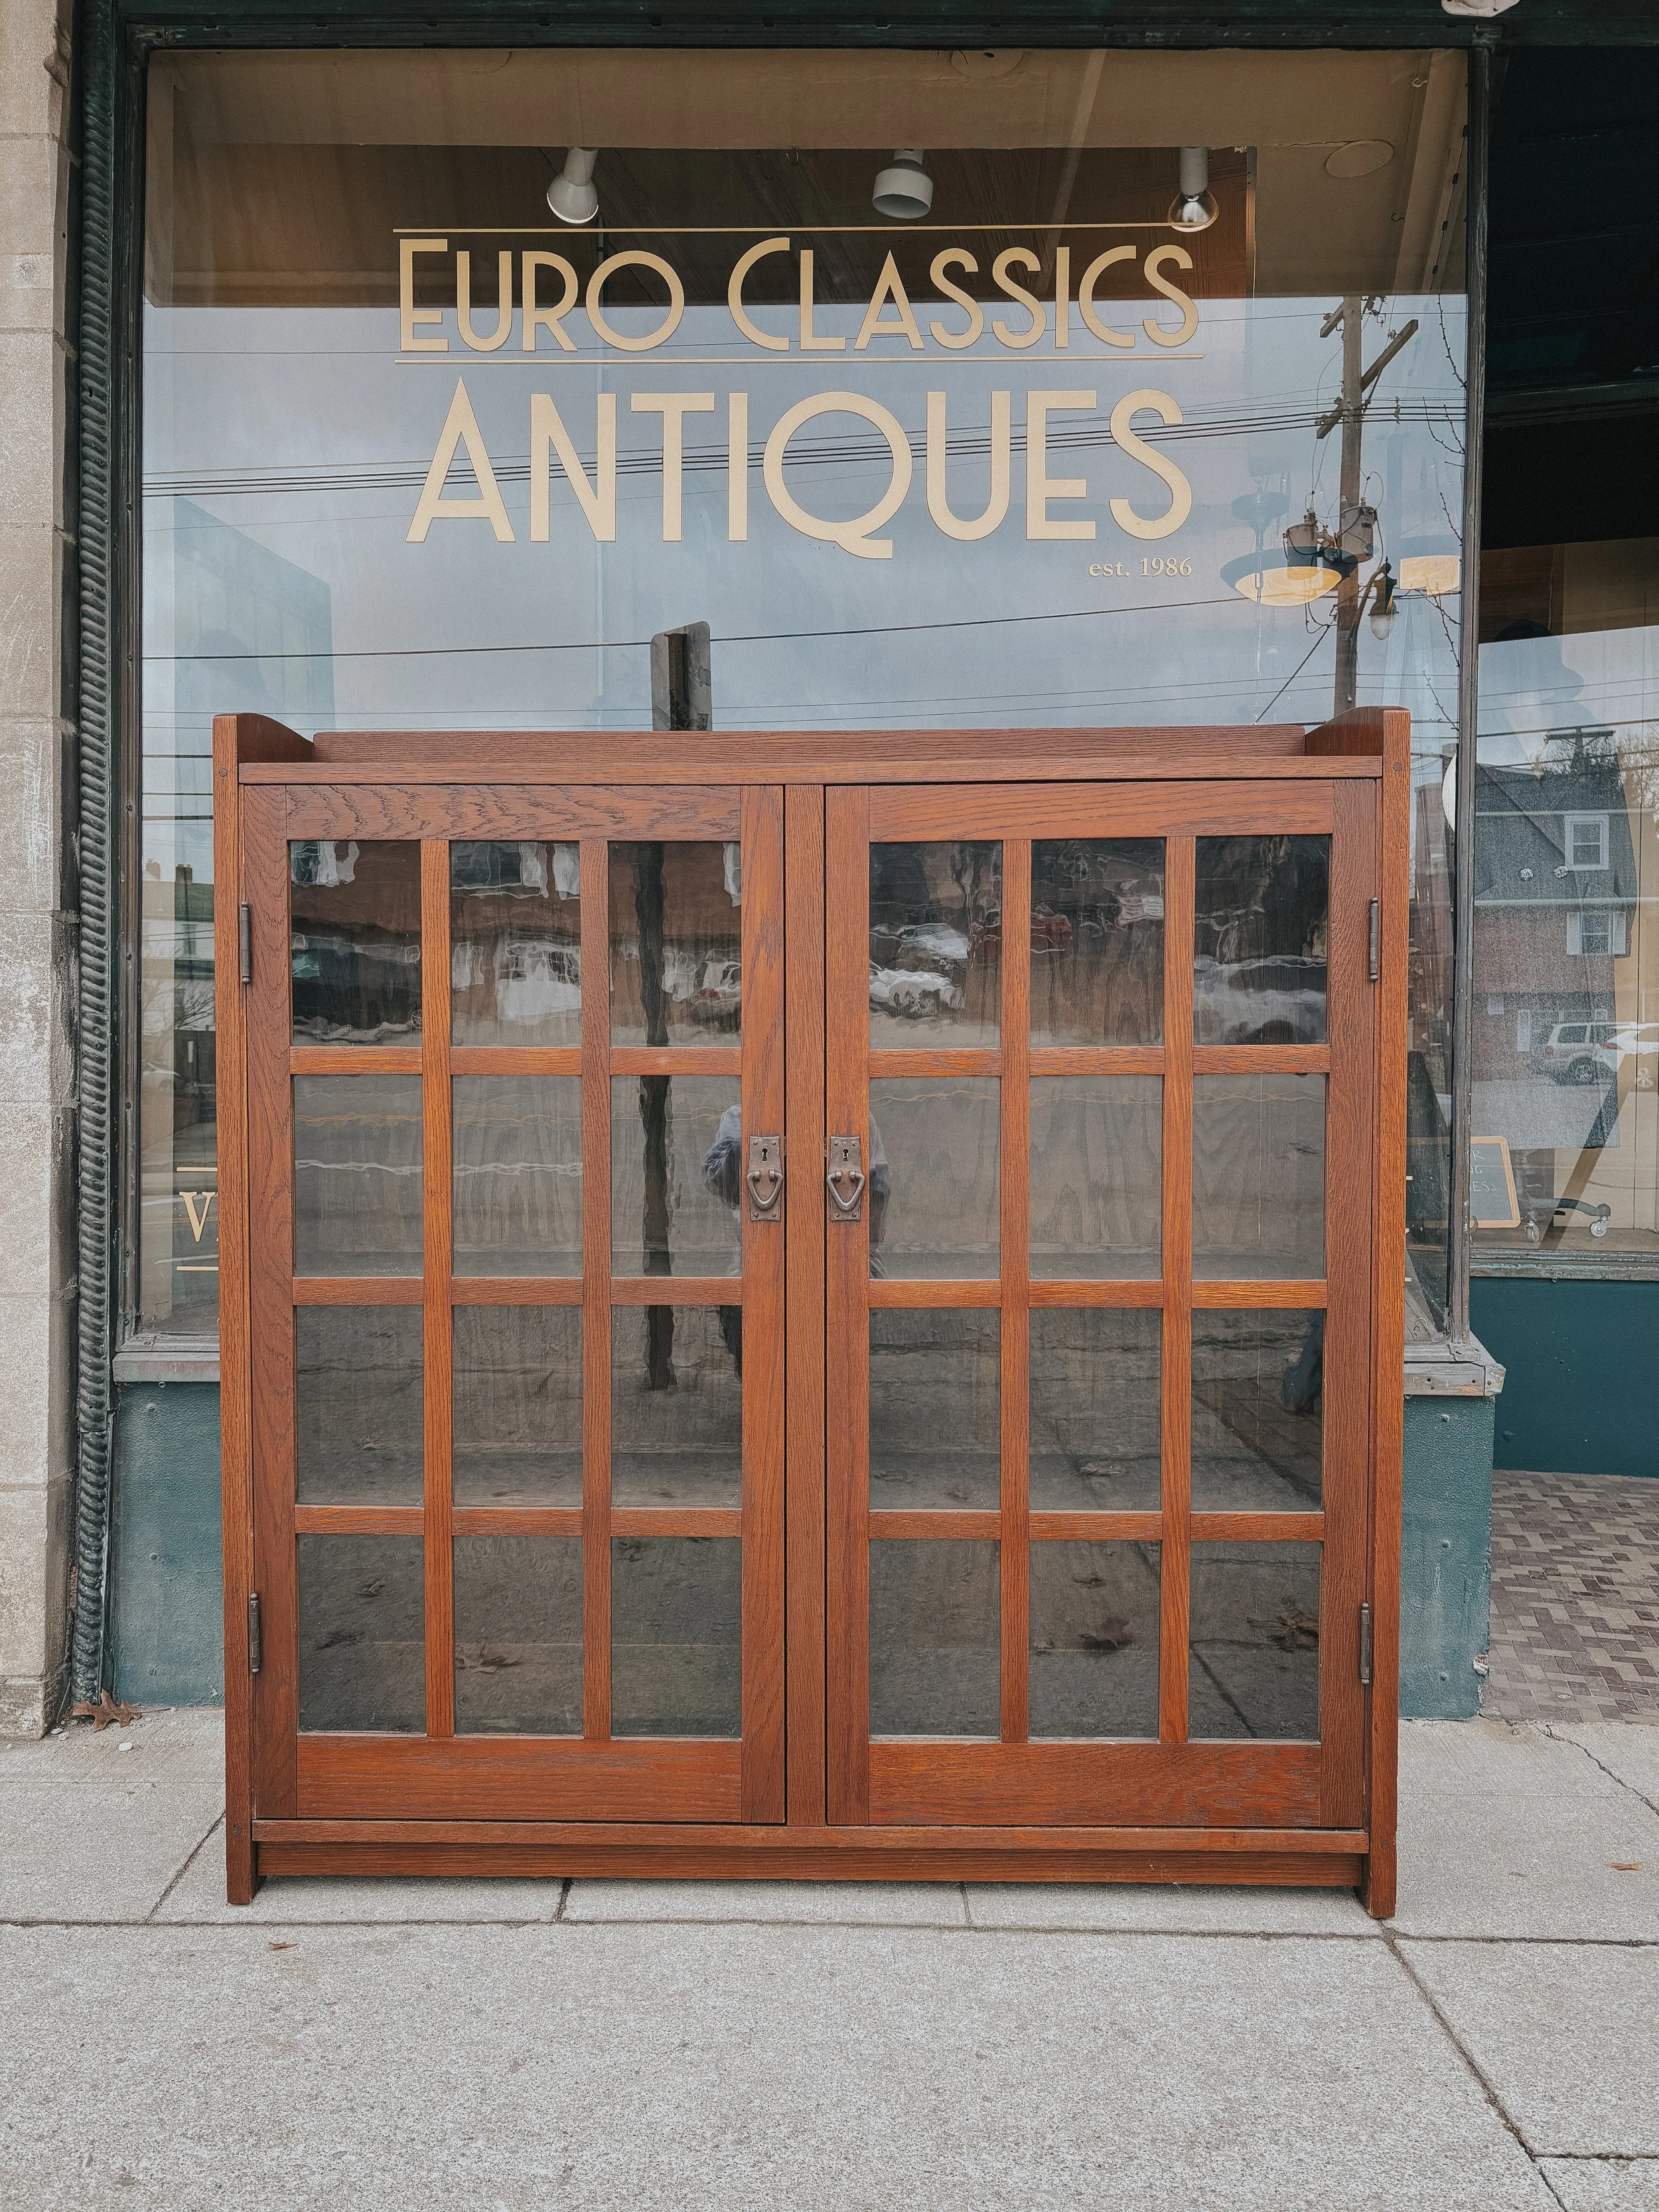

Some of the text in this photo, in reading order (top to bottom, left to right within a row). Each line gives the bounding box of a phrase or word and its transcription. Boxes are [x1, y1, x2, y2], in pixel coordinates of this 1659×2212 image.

[399, 237, 1199, 351] EURO CLASSICS
[405, 376, 1192, 559] ANTIQUES
[1088, 557, 1192, 577] est. 1986
